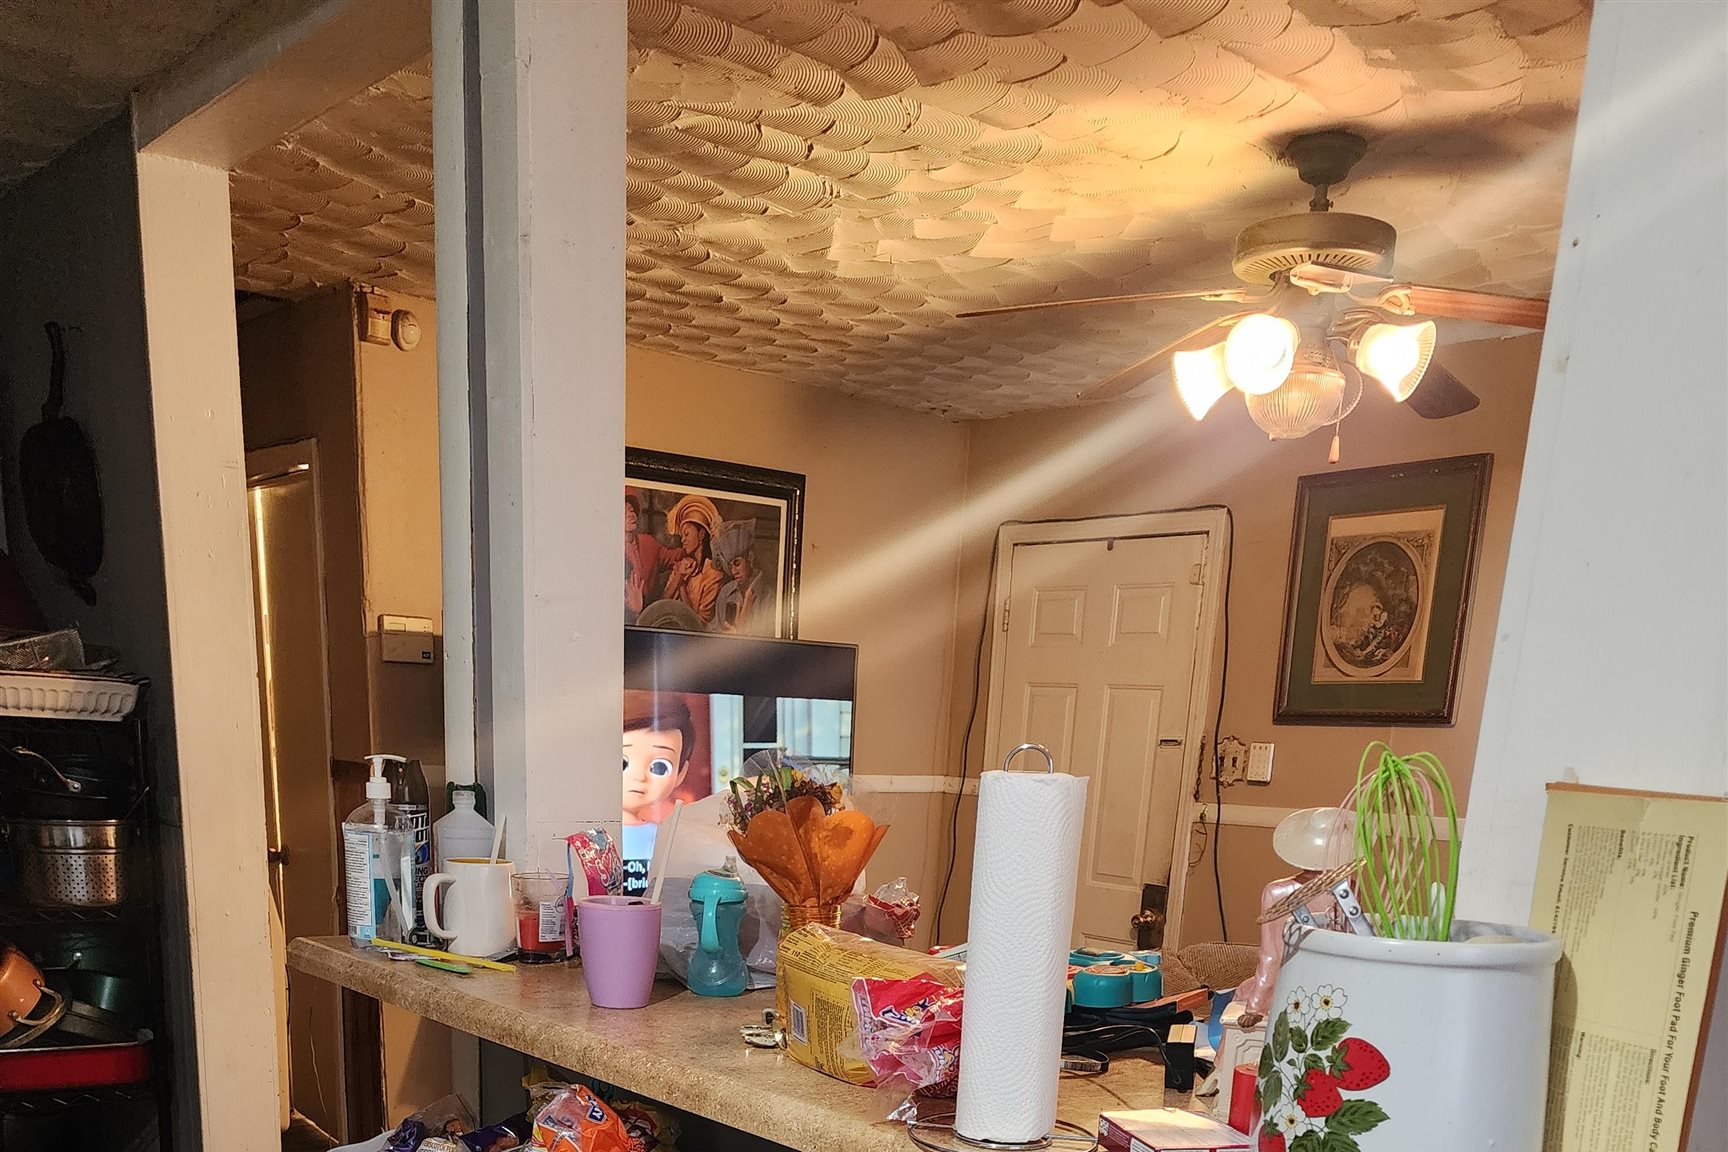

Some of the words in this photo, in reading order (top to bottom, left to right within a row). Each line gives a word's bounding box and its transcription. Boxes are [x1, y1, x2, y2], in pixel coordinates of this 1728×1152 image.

[1684, 911, 1699, 955] Premium
[1676, 957, 1691, 990] Ginger
[1672, 990, 1685, 1012] Foot
[1669, 1014, 1680, 1032] Pad
[1666, 1034, 1677, 1050] For
[1662, 1052, 1674, 1072] Your
[1657, 1073, 1670, 1096] Foot
[1654, 1097, 1666, 1116] And
[1649, 1117, 1662, 1141] Body
